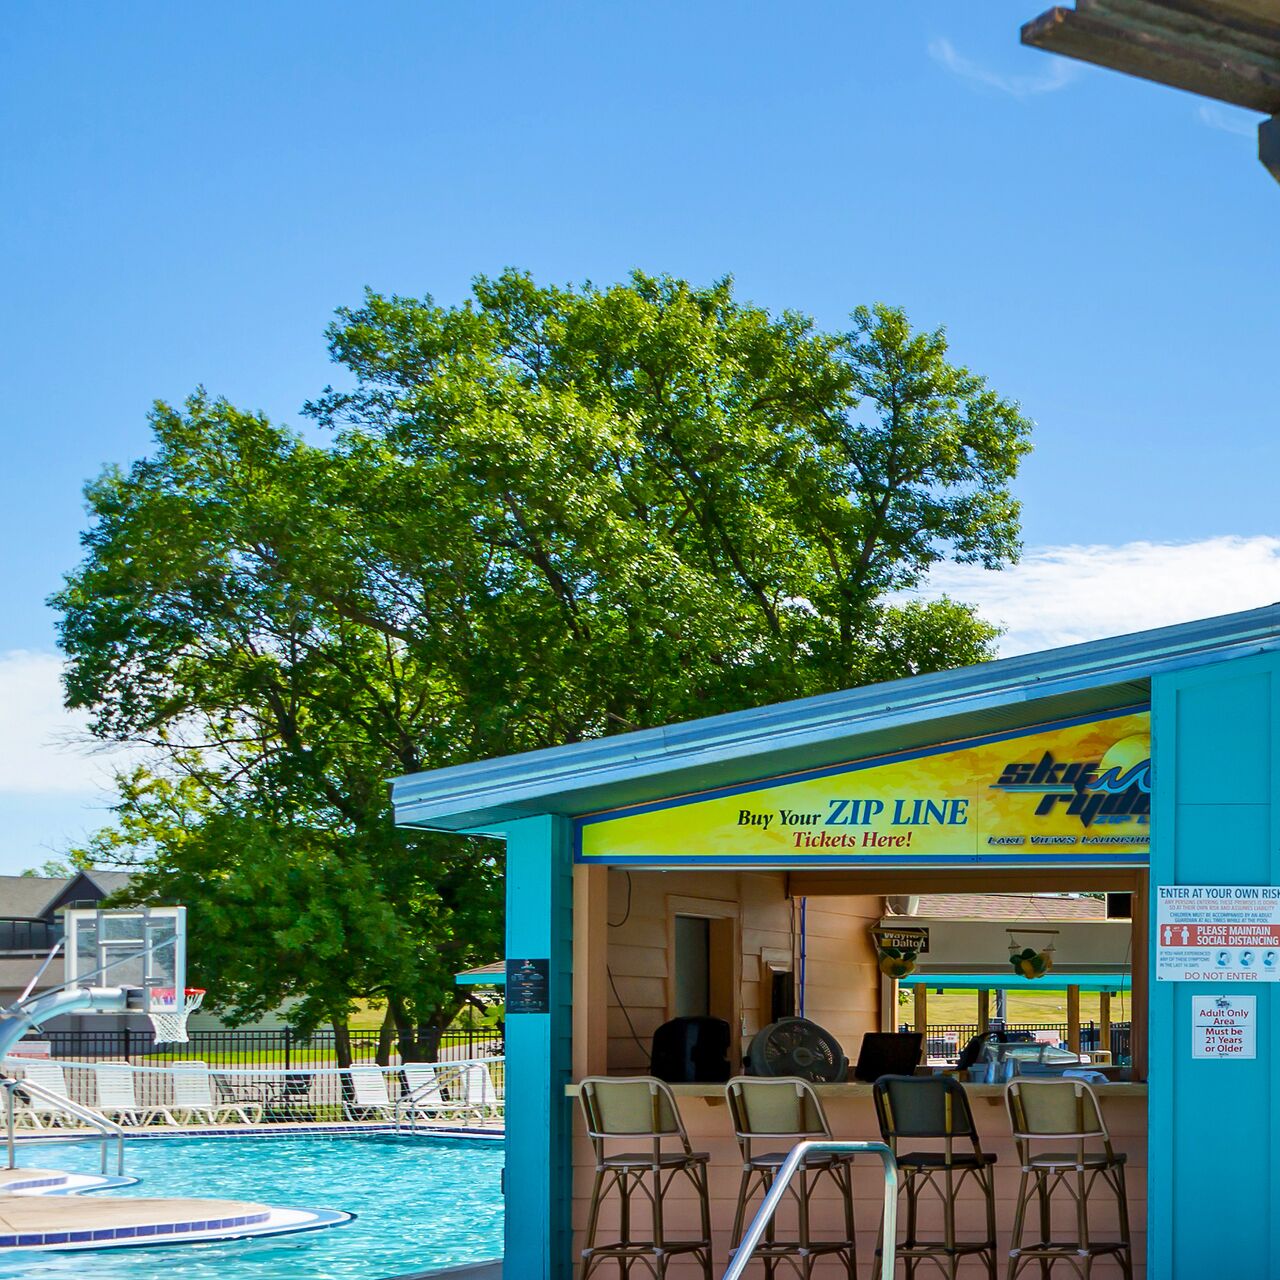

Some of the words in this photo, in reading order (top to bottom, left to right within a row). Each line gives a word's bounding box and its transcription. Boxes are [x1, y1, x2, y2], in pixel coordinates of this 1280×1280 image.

[737, 809, 773, 830] Buy
[779, 809, 821, 826] Your
[824, 799, 884, 826] ZIP
[891, 799, 969, 826] LINE
[793, 831, 856, 848] Tickets
[861, 831, 912, 848] Here!
[987, 836, 1025, 845] LAKE
[1030, 836, 1077, 845] VIEWS
[1161, 888, 1189, 899] ENTER
[1192, 888, 1205, 899] AT
[1205, 888, 1232, 899] YOUR
[1235, 888, 1258, 899] OWN
[1197, 926, 1227, 935] PLEASE
[1229, 926, 1271, 935] MAINTAIN
[1196, 936, 1226, 945] SOCIAL
[1228, 936, 1279, 945] DISTANCING
[1184, 972, 1200, 980] DO
[1203, 972, 1225, 980] NOT
[1227, 972, 1258, 980] ENTER
[1200, 1009, 1225, 1017] Adult
[1227, 1009, 1249, 1019] Only
[1205, 1036, 1215, 1044] 21
[1218, 1036, 1243, 1044] Years
[1217, 1045, 1243, 1053] Older
